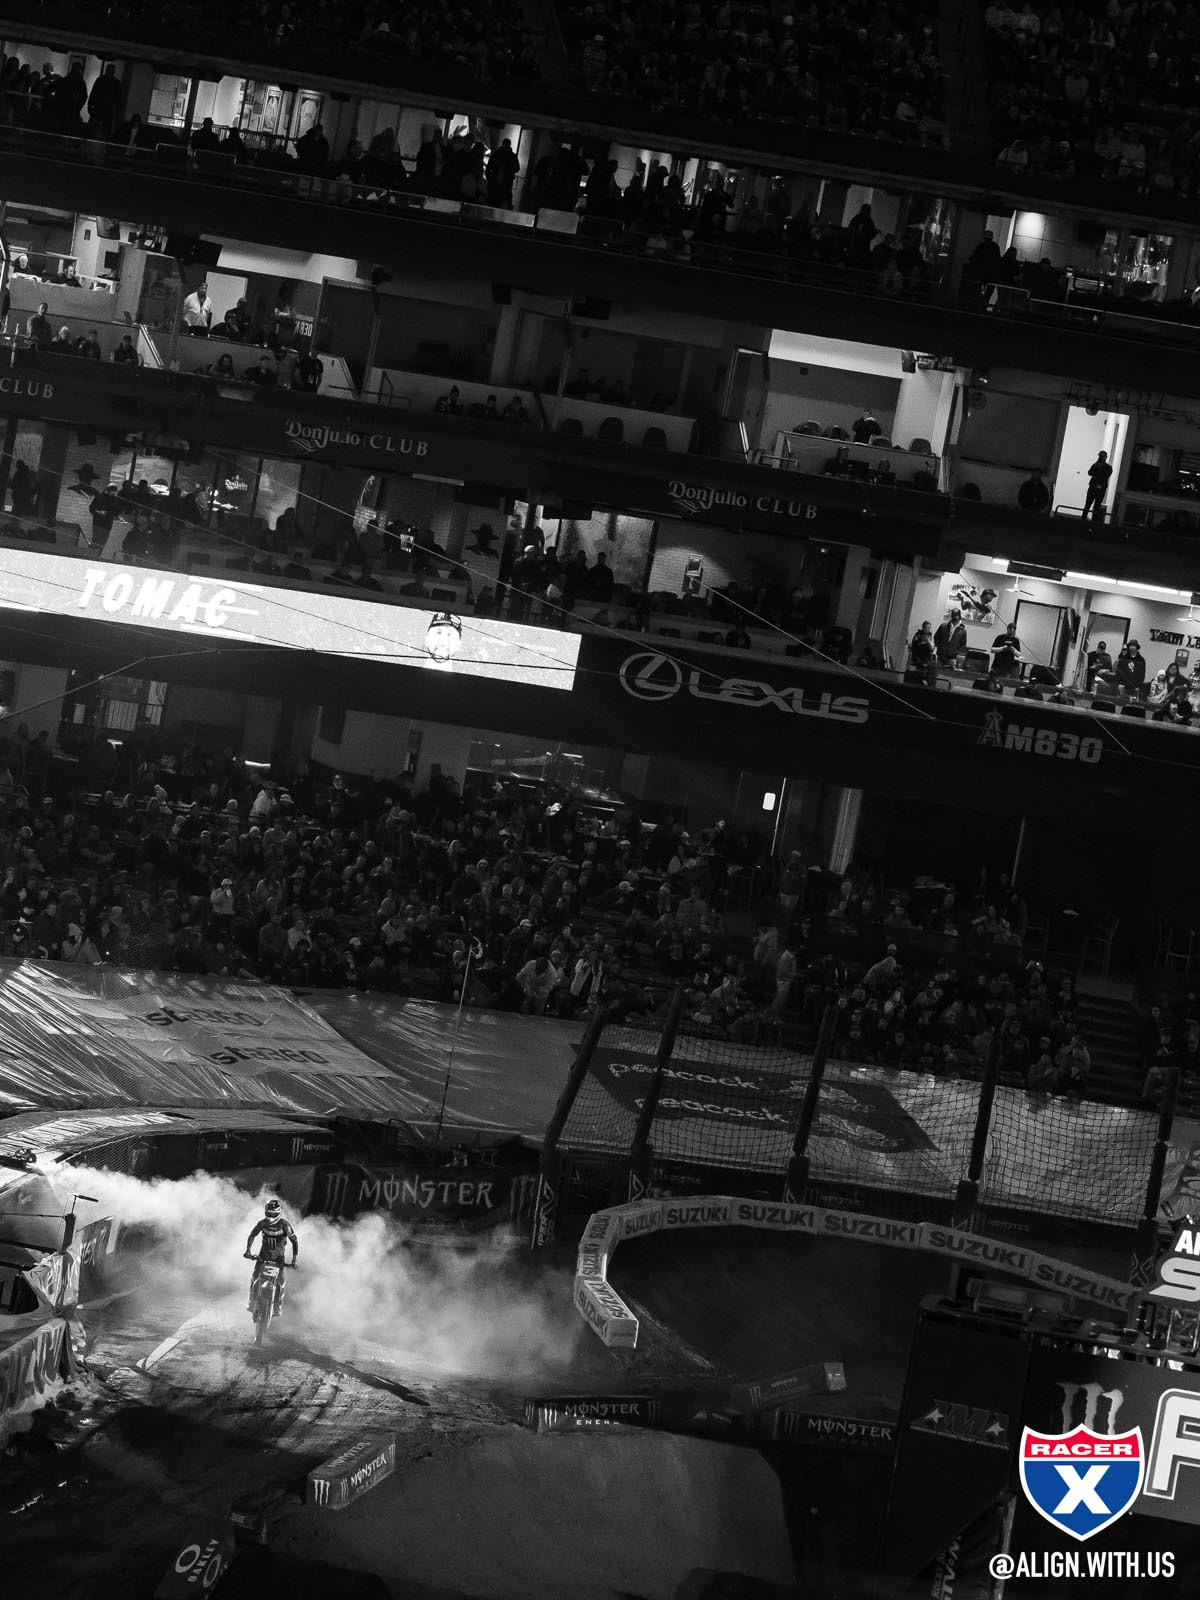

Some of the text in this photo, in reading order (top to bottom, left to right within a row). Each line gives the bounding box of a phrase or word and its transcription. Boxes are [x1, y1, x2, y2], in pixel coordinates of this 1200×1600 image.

[369, 434, 429, 456] CLUB
[756, 496, 817, 520] CLUB
[77, 567, 237, 628] TOMAC
[688, 670, 870, 724] LEXUS
[625, 1209, 662, 1235] SUZUKI
[666, 1207, 728, 1224] SUZUKI
[739, 1203, 814, 1227] SUZUKI
[824, 1214, 917, 1243] SUZUKI
[928, 1231, 1026, 1270] SUZUKI
[1036, 1264, 1128, 1309] SUZUK
